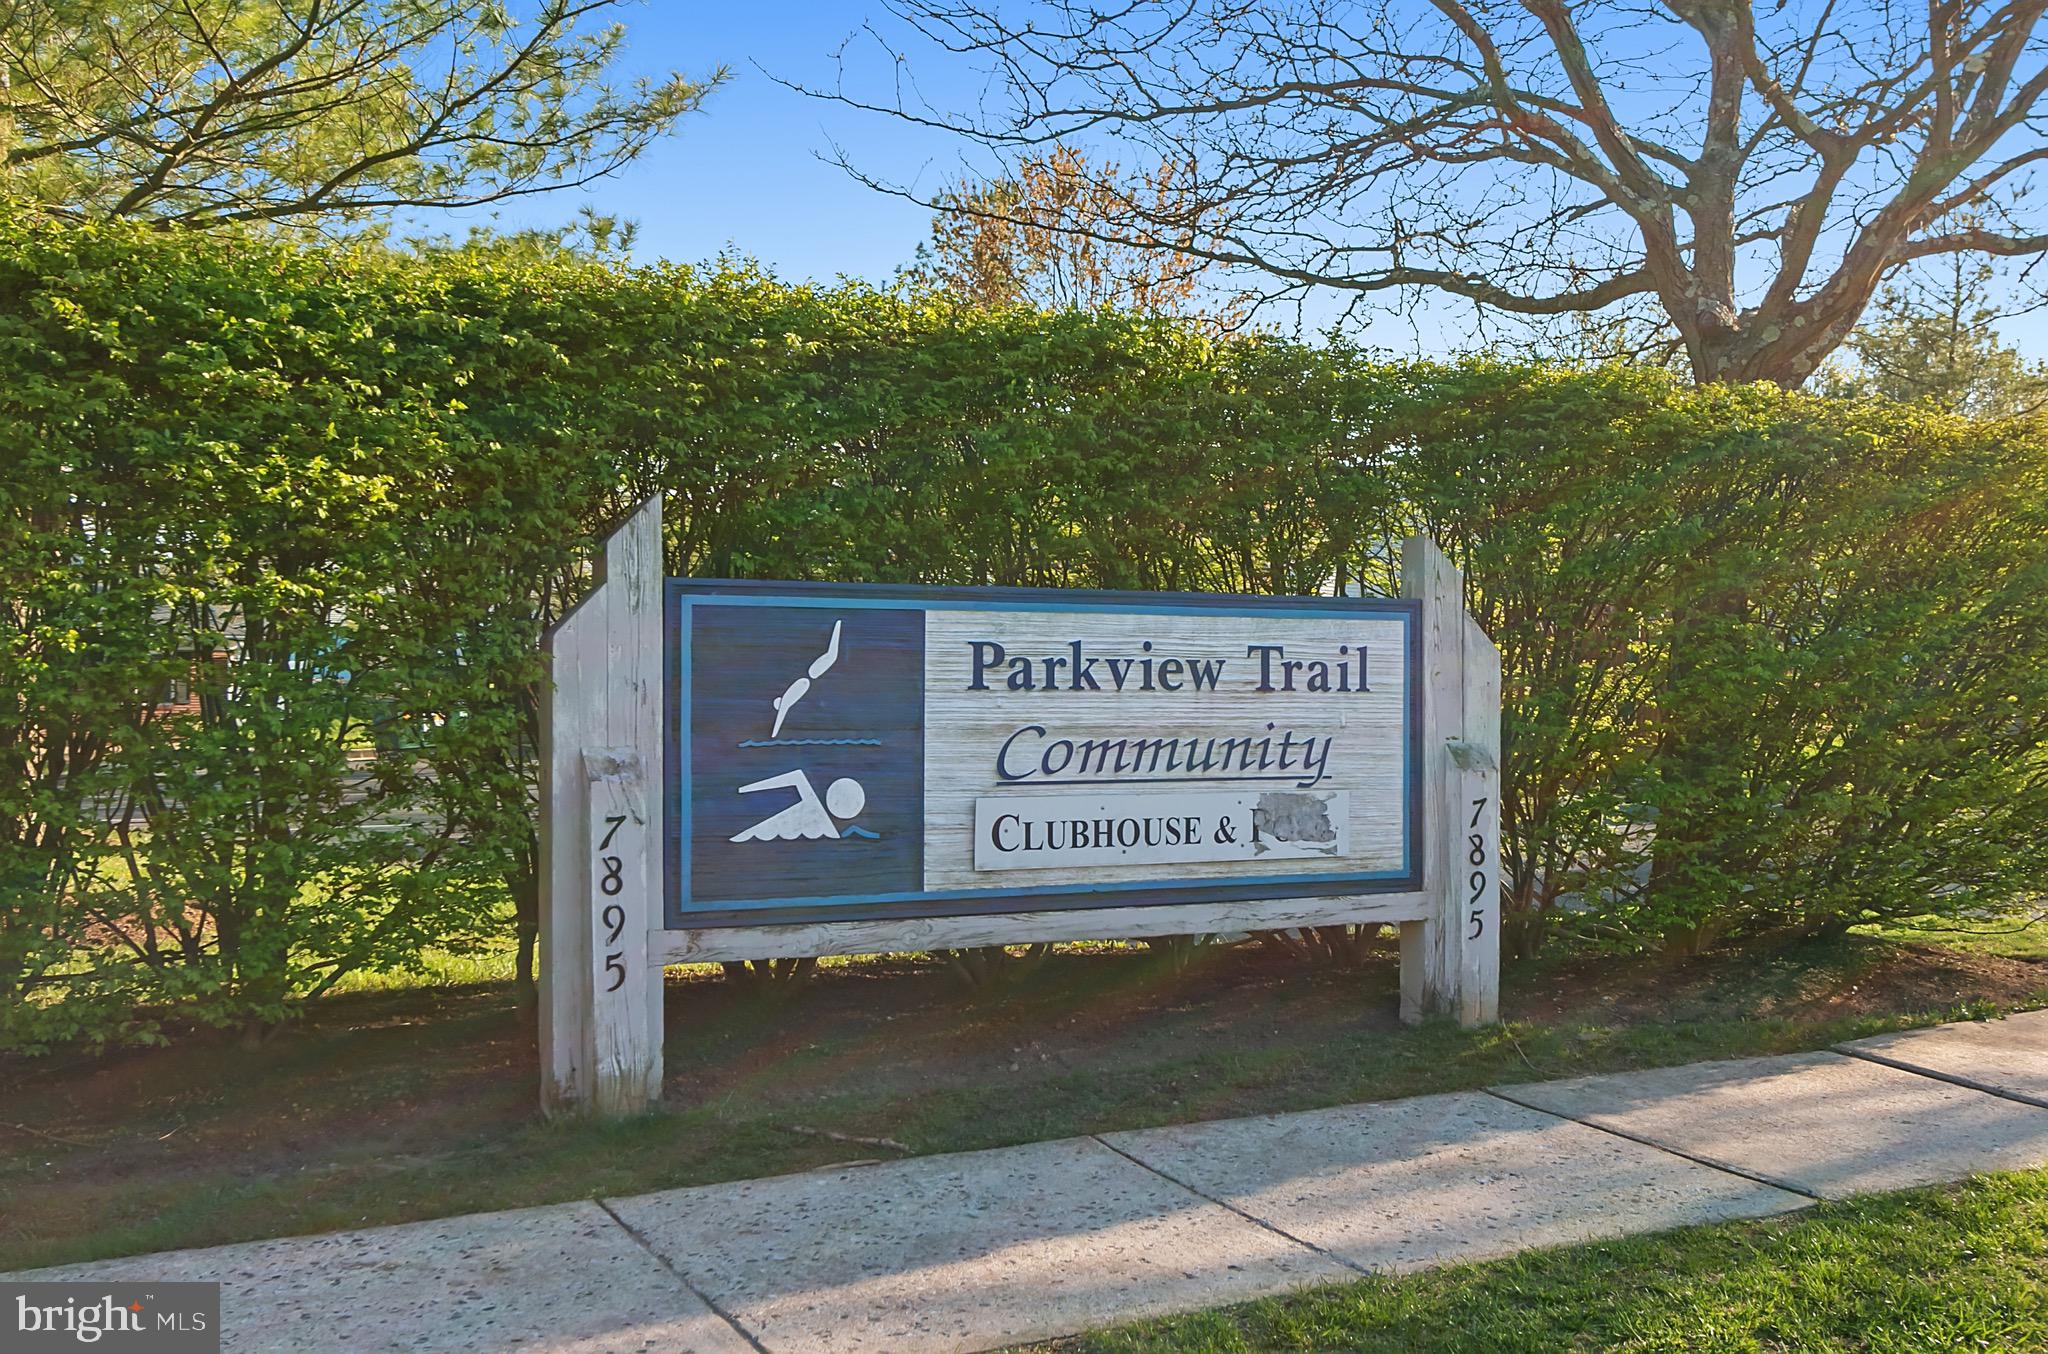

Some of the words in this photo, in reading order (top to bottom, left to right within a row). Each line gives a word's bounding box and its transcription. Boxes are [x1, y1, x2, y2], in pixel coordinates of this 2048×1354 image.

[967, 640, 1226, 692] Parkview
[1246, 644, 1371, 692] Trail
[995, 721, 1333, 788] Community
[991, 813, 1202, 852] CLUBHOUSE
[1213, 815, 1237, 844] &
[1468, 797, 1488, 940] 7895
[599, 814, 626, 992] 7895
